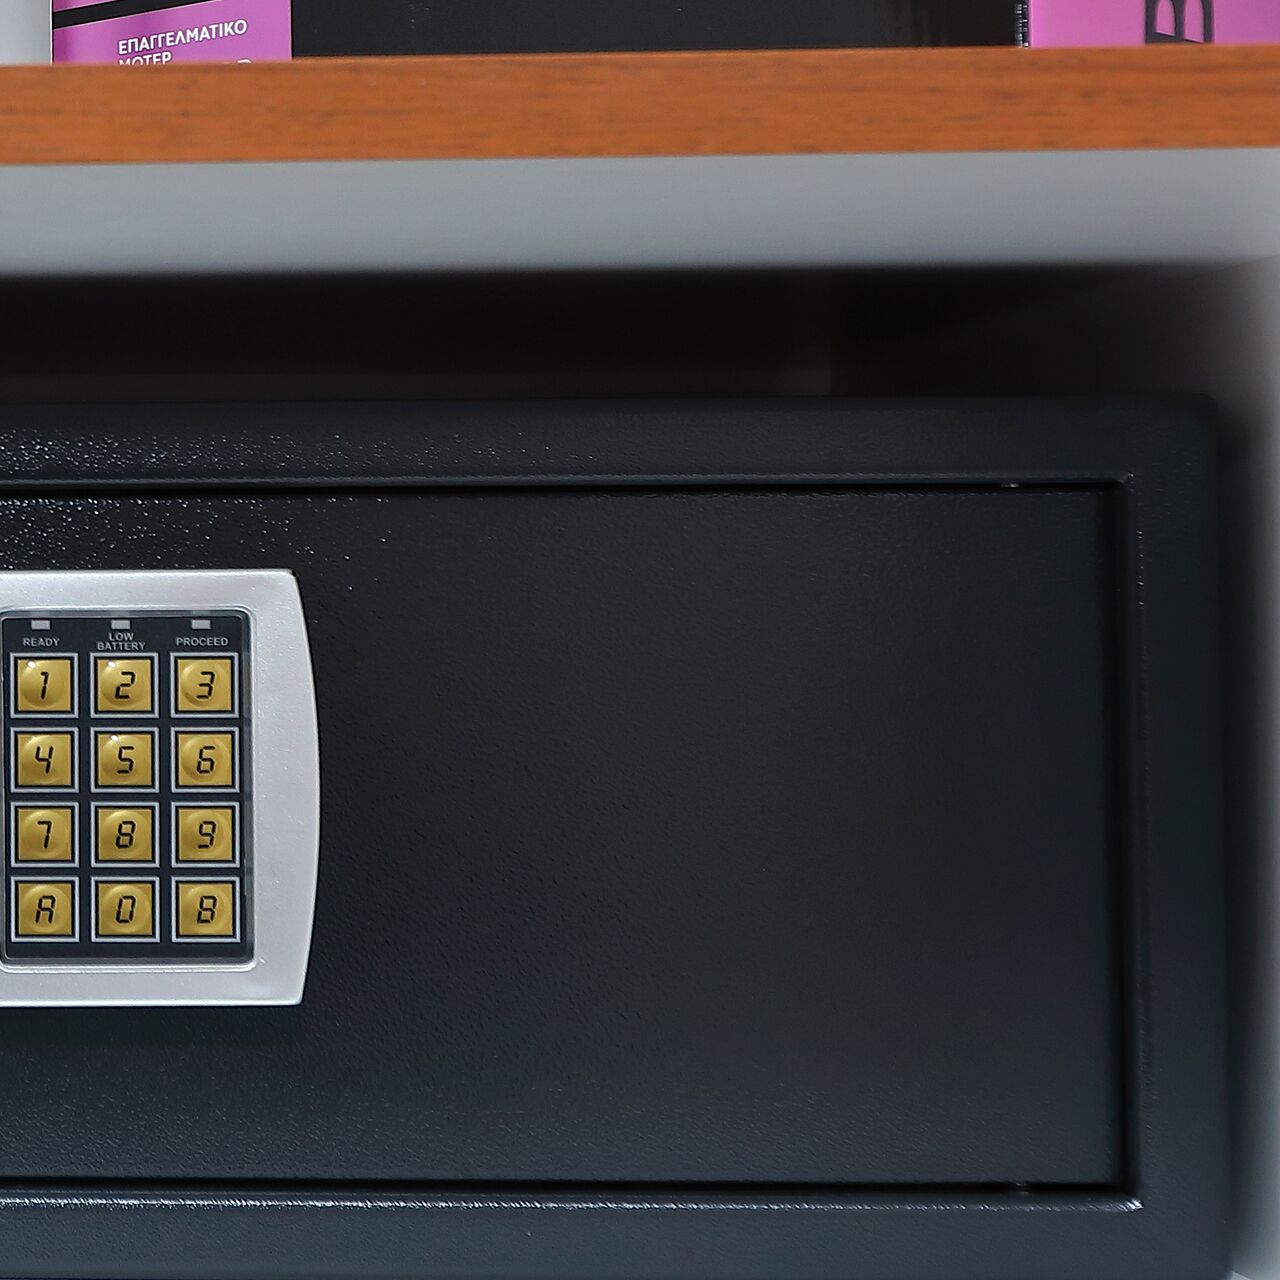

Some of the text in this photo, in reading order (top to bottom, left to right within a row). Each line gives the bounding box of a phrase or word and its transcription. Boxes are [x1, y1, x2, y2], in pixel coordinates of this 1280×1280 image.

[118, 19, 248, 55] ΕΠΑΓΓΕΛΜΑΤΙΚΟ
[23, 637, 60, 647] READY
[97, 641, 146, 651] BATTERY
[108, 632, 134, 642] LOW
[176, 637, 229, 647] PROCEED
[39, 671, 49, 700] 1
[114, 671, 136, 699] 2
[196, 671, 216, 699] 3
[34, 745, 54, 774] 4
[116, 745, 135, 774] 5
[196, 745, 216, 774] 6
[36, 820, 53, 849] 7
[114, 820, 137, 849] 8
[197, 820, 217, 849] 9
[35, 895, 56, 924] A
